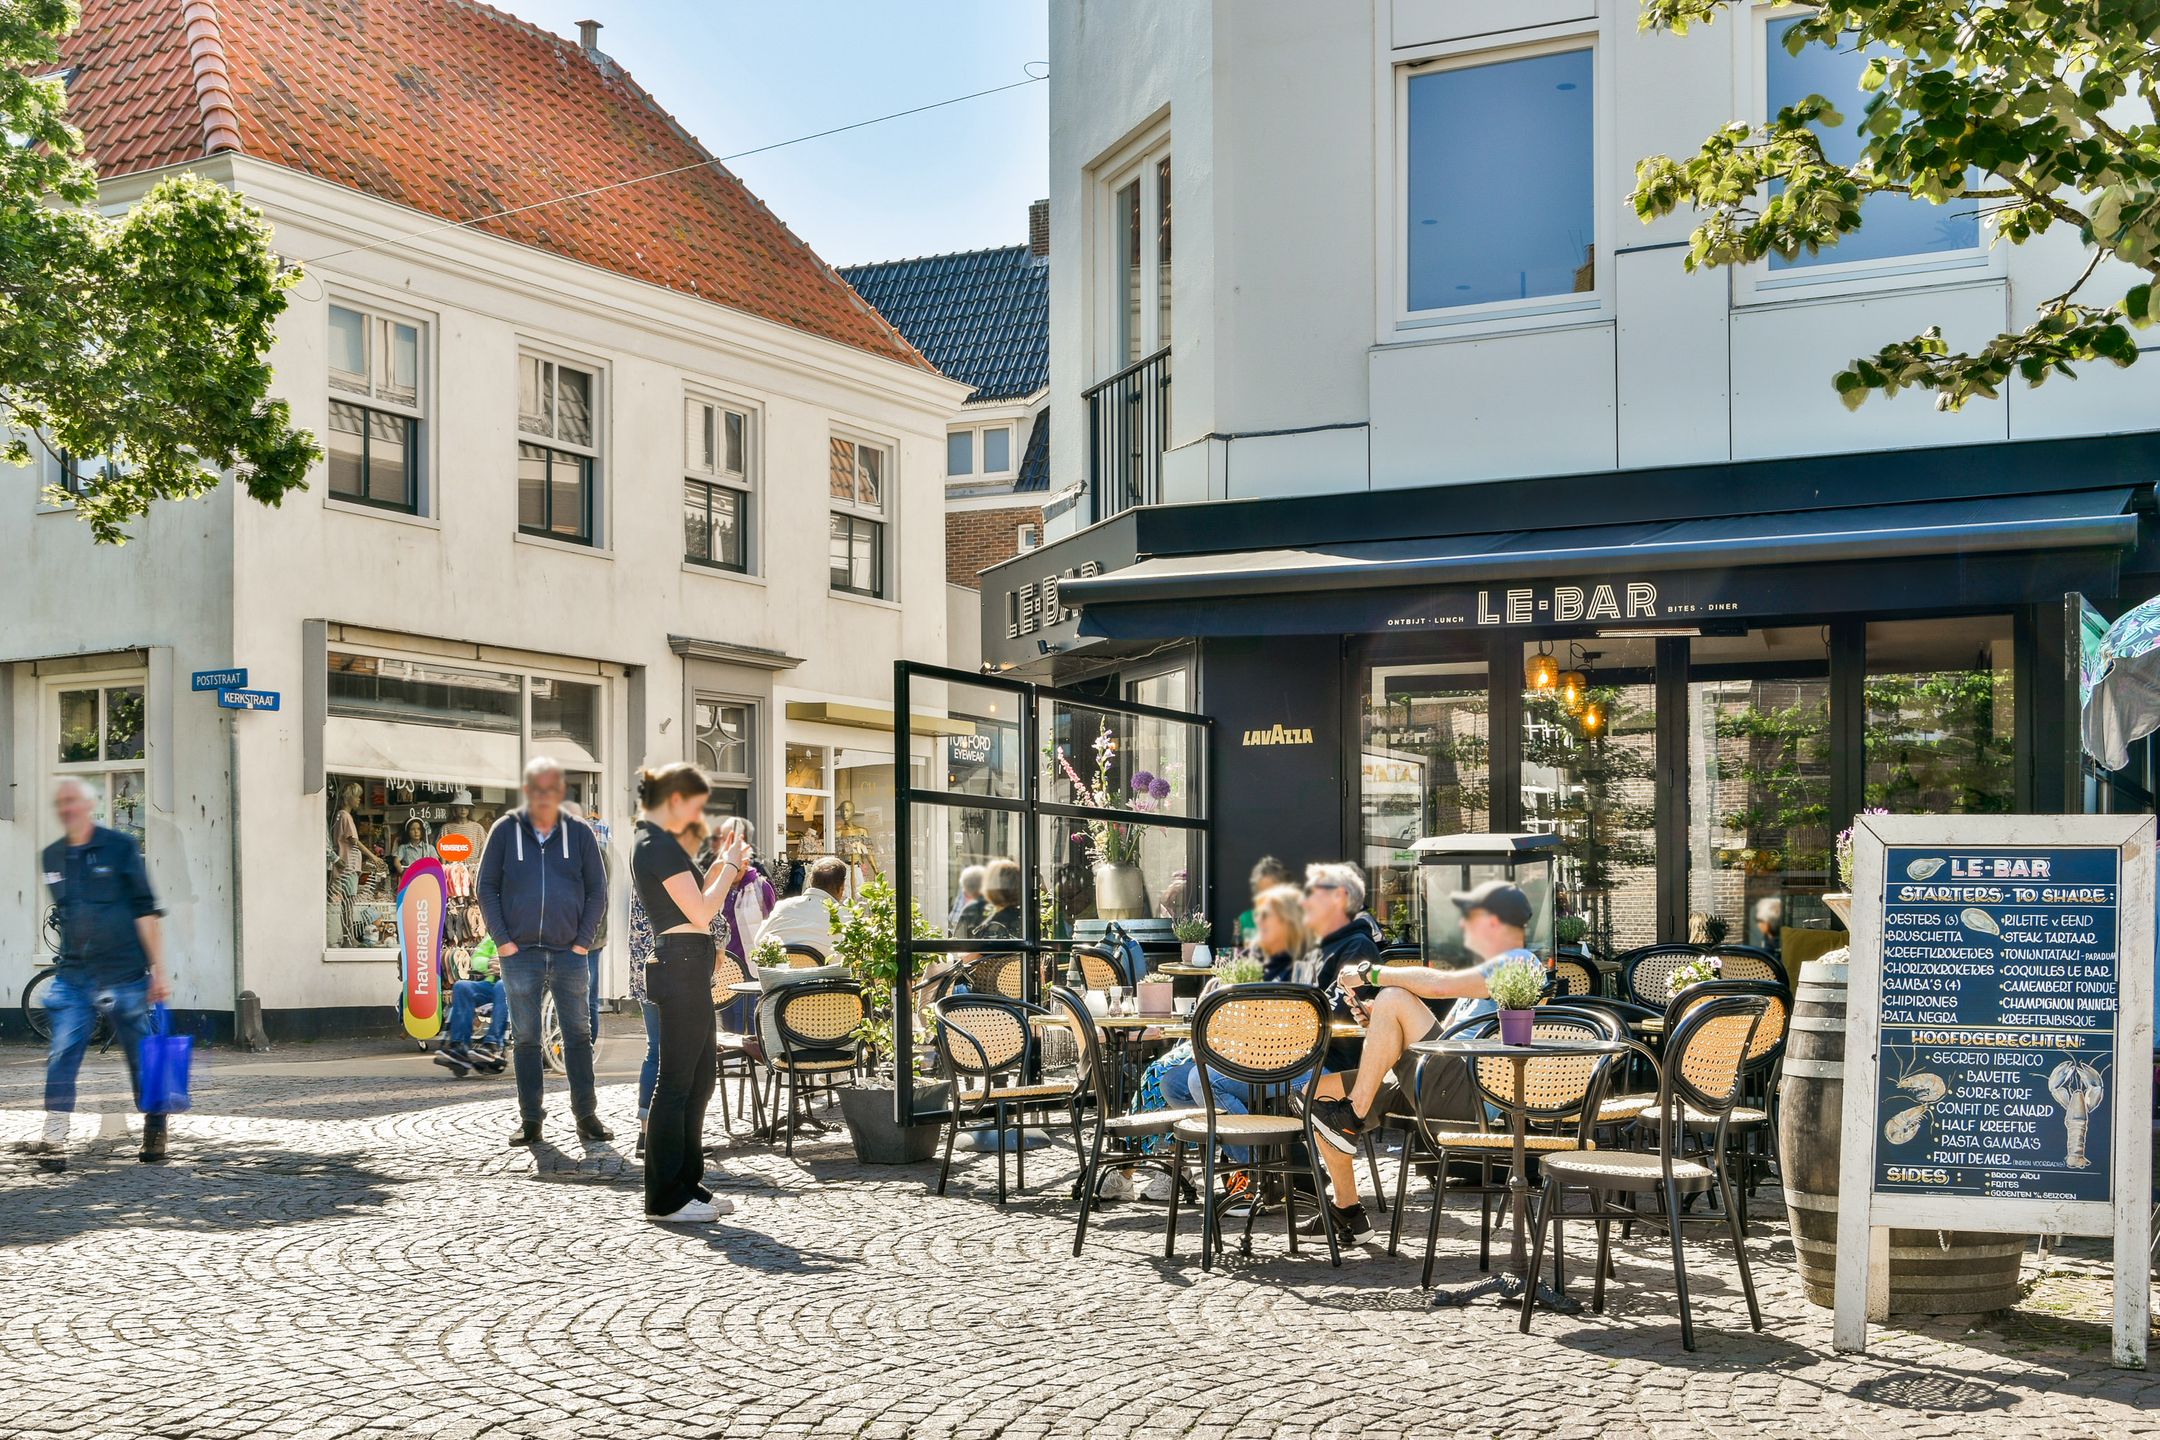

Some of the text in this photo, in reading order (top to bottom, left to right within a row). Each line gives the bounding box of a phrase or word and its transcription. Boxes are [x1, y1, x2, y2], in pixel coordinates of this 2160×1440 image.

[1667, 603, 1739, 613] BITES DINER
[1387, 616, 1464, 626] ONTBIJT LUNCH
[196, 673, 241, 686] POSTSTRAAT
[224, 692, 274, 706] KERKSTRAAT
[1242, 724, 1314, 746] LAVAZZA
[968, 735, 991, 751] FORD
[954, 749, 985, 763] EYEWEAR
[1888, 914, 1959, 926] OESTERS (3)
[2004, 914, 2048, 926] RILETTE
[2060, 914, 2093, 927] EEND
[1888, 931, 1963, 943] BRUSCHETTA
[2004, 931, 2098, 944] STEAK TARTAAR
[415, 899, 430, 995] havaianas
[2004, 965, 2112, 978] COQUILLES LE BAR
[1885, 978, 1961, 991] GAMBA'S (4)
[2003, 981, 2117, 995] CAMEMBERT FONDUE
[1884, 995, 1958, 1008] CHIPIRONES
[2002, 998, 2074, 1011] CHAMPIGNON
[1884, 1011, 1958, 1024] PATA NEGRA
[2002, 1014, 2096, 1027] KREEFTENBISQUE
[1932, 1052, 2044, 1067] SECRETO IBERICO
[1966, 1071, 2021, 1083] BAVETTE
[1936, 1102, 2054, 1117] CONFIT DE CANARD
[1942, 1120, 2037, 1133] HALF KREEFTJE
[1941, 1137, 2041, 1150] PASTA GAMBA'S
[1933, 1151, 1965, 1164] FRUIT
[1991, 1171, 2018, 1180] BROOD
[1991, 1181, 2019, 1189] FRITES
[1990, 1189, 2032, 1198] GROENTEN
[2042, 1192, 2076, 1200] SEIZOEN
